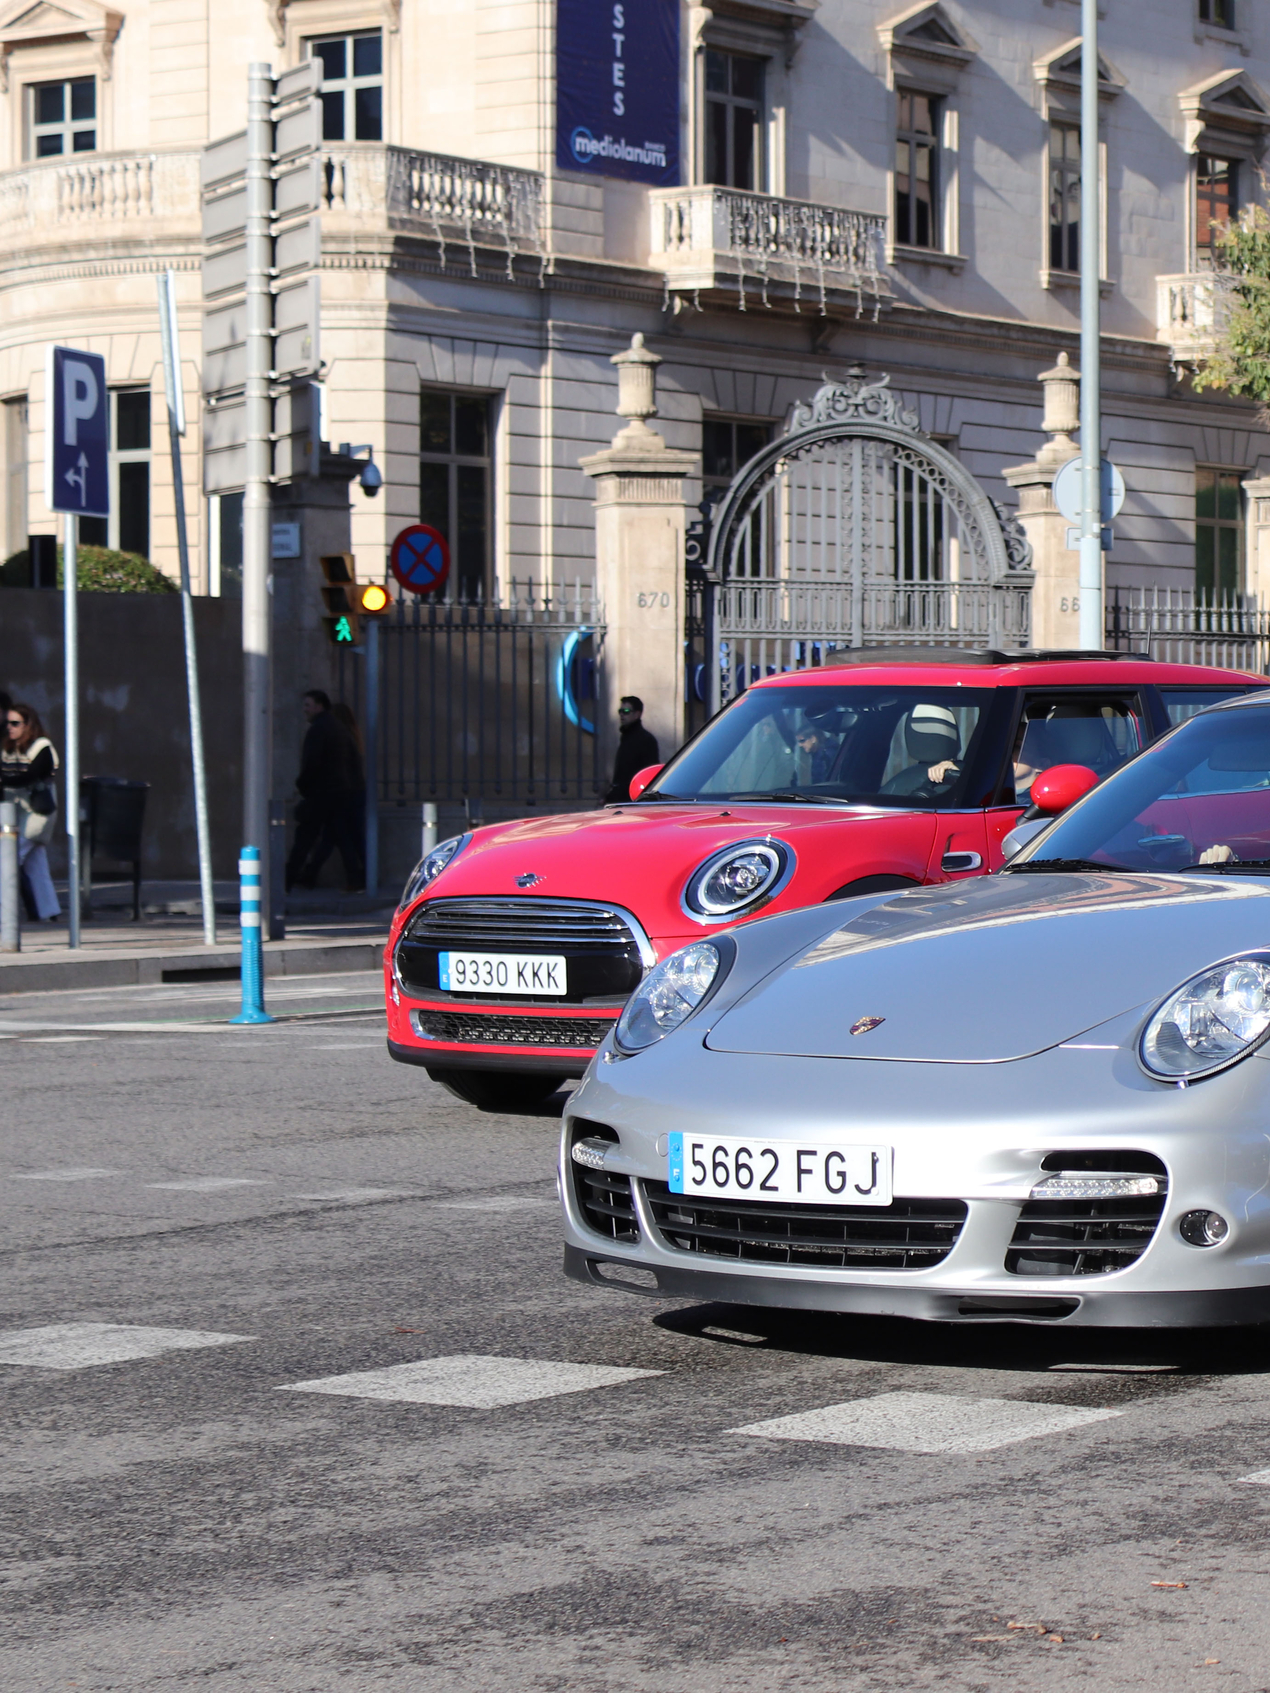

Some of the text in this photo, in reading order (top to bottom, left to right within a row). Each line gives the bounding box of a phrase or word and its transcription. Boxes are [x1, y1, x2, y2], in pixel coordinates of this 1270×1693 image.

[575, 135, 667, 167] mediolanum
[63, 360, 99, 446] P
[638, 591, 670, 609] 670
[455, 959, 559, 989] 9330 KKK
[691, 1143, 879, 1195] 5662 FGJ
